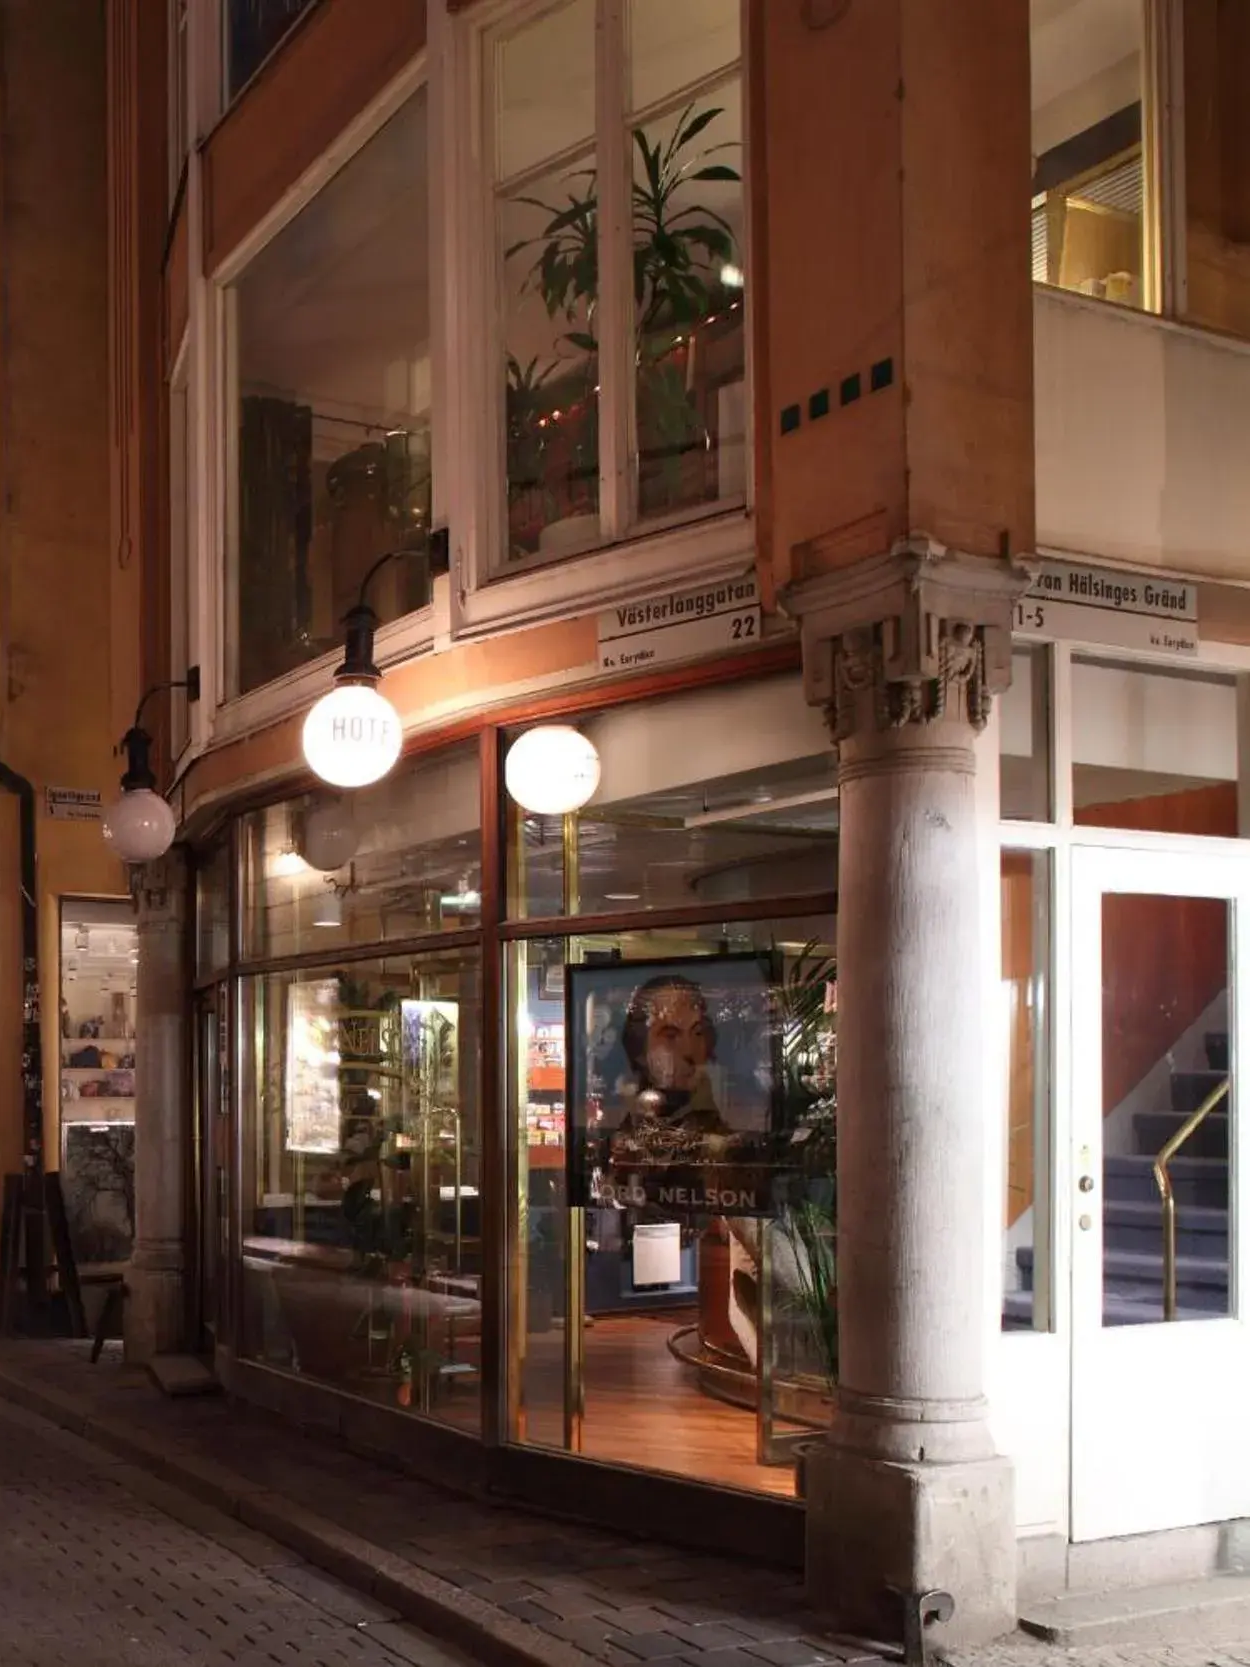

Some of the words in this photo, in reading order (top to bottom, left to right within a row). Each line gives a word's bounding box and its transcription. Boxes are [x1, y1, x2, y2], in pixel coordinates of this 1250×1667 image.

[1068, 572, 1138, 607] Hälsinges
[1144, 584, 1187, 611] Gränd
[1017, 603, 1045, 628] 1-5
[731, 616, 756, 640] 22
[658, 1186, 757, 1209] NELSON
